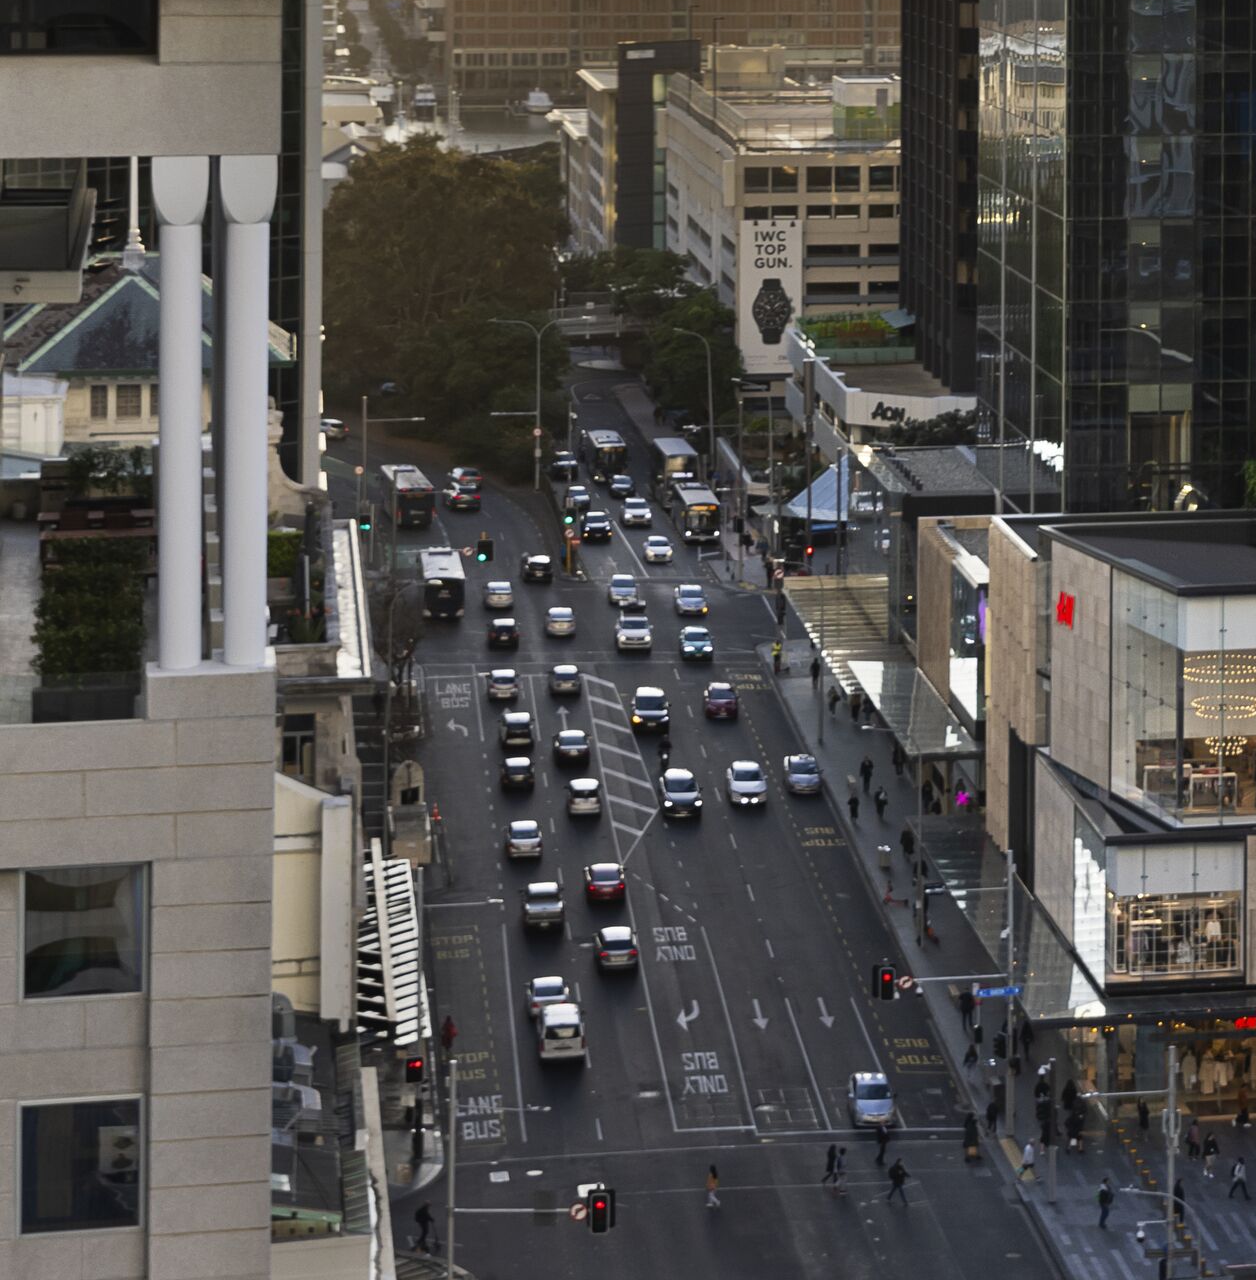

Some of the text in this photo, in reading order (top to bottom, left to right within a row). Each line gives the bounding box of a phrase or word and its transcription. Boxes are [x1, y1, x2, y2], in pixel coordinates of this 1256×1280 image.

[754, 231, 786, 242] IWC
[755, 244, 787, 256] TOP
[754, 257, 793, 269] GUN.
[653, 926, 688, 942] BUS
[656, 945, 697, 961] ONLY
[453, 1051, 489, 1063] TOP
[681, 1052, 719, 1071] BUS
[684, 1074, 729, 1094] ONLY
[462, 1119, 501, 1140] BUS
